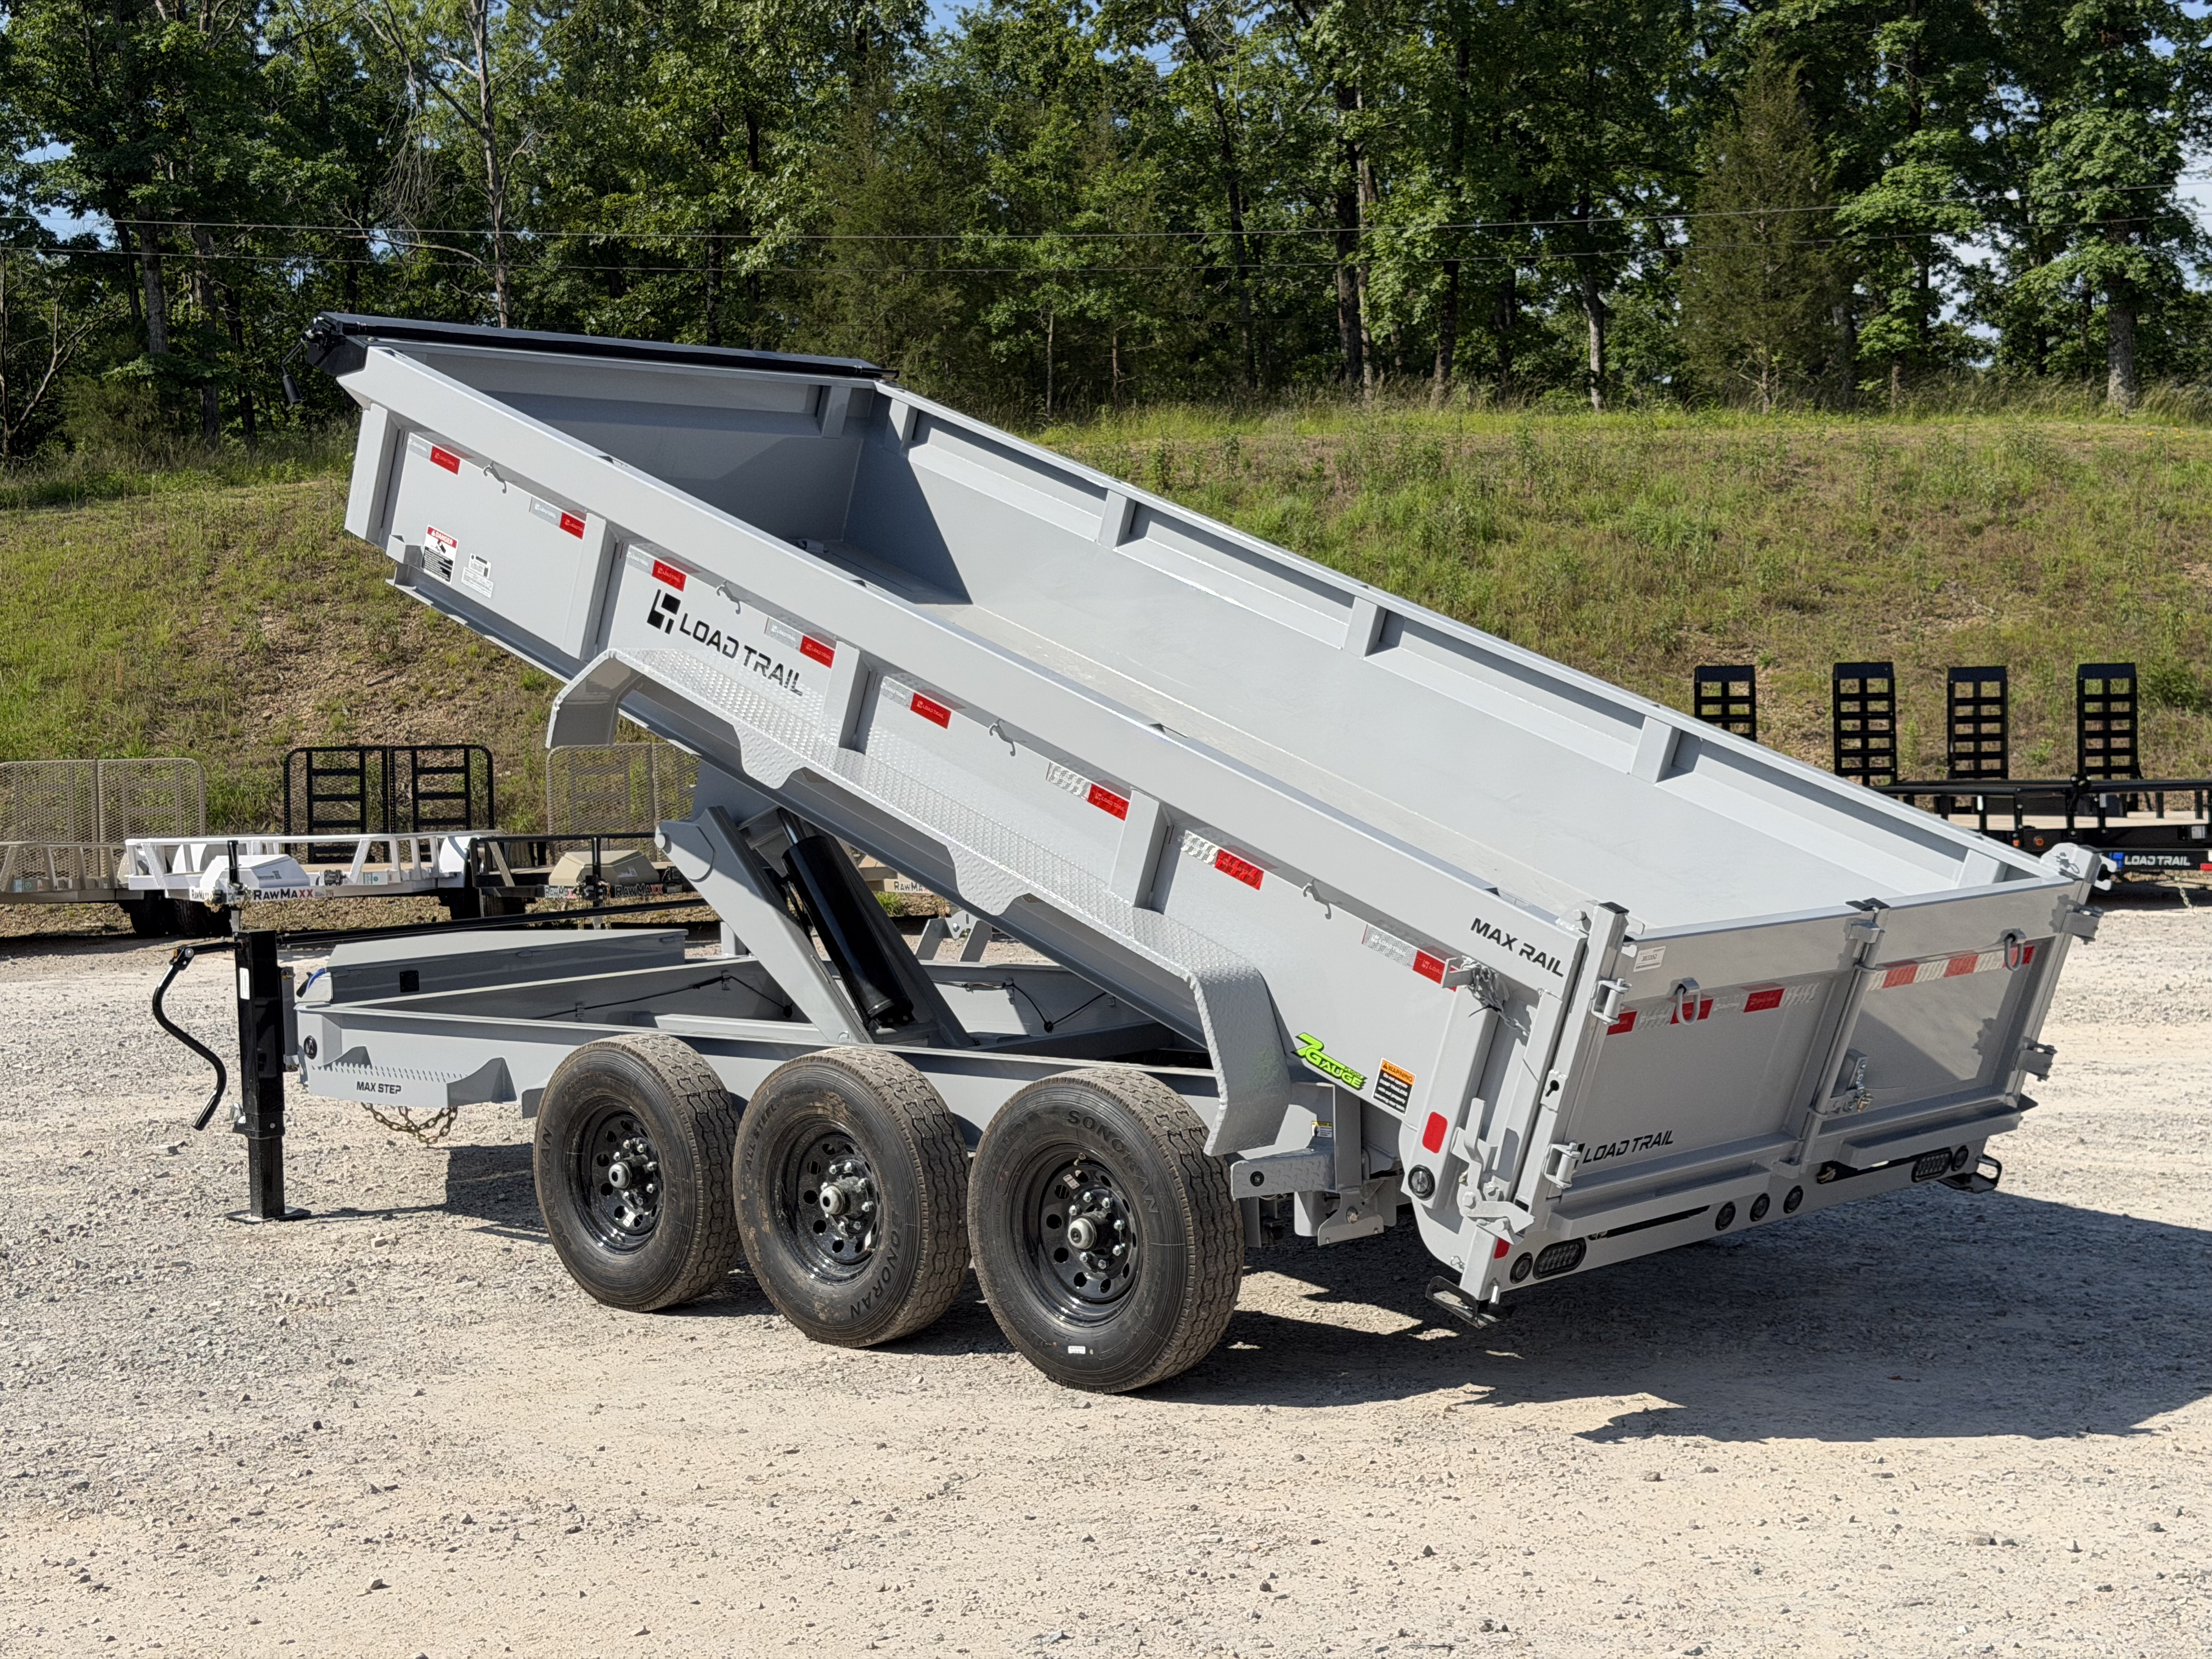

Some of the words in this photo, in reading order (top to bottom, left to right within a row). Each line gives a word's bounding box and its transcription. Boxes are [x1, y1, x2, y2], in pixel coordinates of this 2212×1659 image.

[436, 531, 454, 545] DANGER
[679, 613, 740, 659] LOAD
[743, 645, 803, 697] TRAIL
[2124, 855, 2156, 866] LOAD
[2157, 855, 2191, 866] TRAIL
[1470, 917, 1518, 952] MAX
[1519, 943, 1564, 978] RAIL
[1295, 1032, 1324, 1057] 7
[1305, 1047, 1365, 1089] GAUGE
[1388, 1064, 1413, 1082] WARNING
[357, 1081, 376, 1092] MAX
[377, 1083, 402, 1094] STEP
[1066, 1109, 1159, 1214] SONORAN
[1582, 1139, 1630, 1164] LOAD
[1632, 1130, 1674, 1153] TRAIL
[850, 1210, 902, 1319] SONORAN
